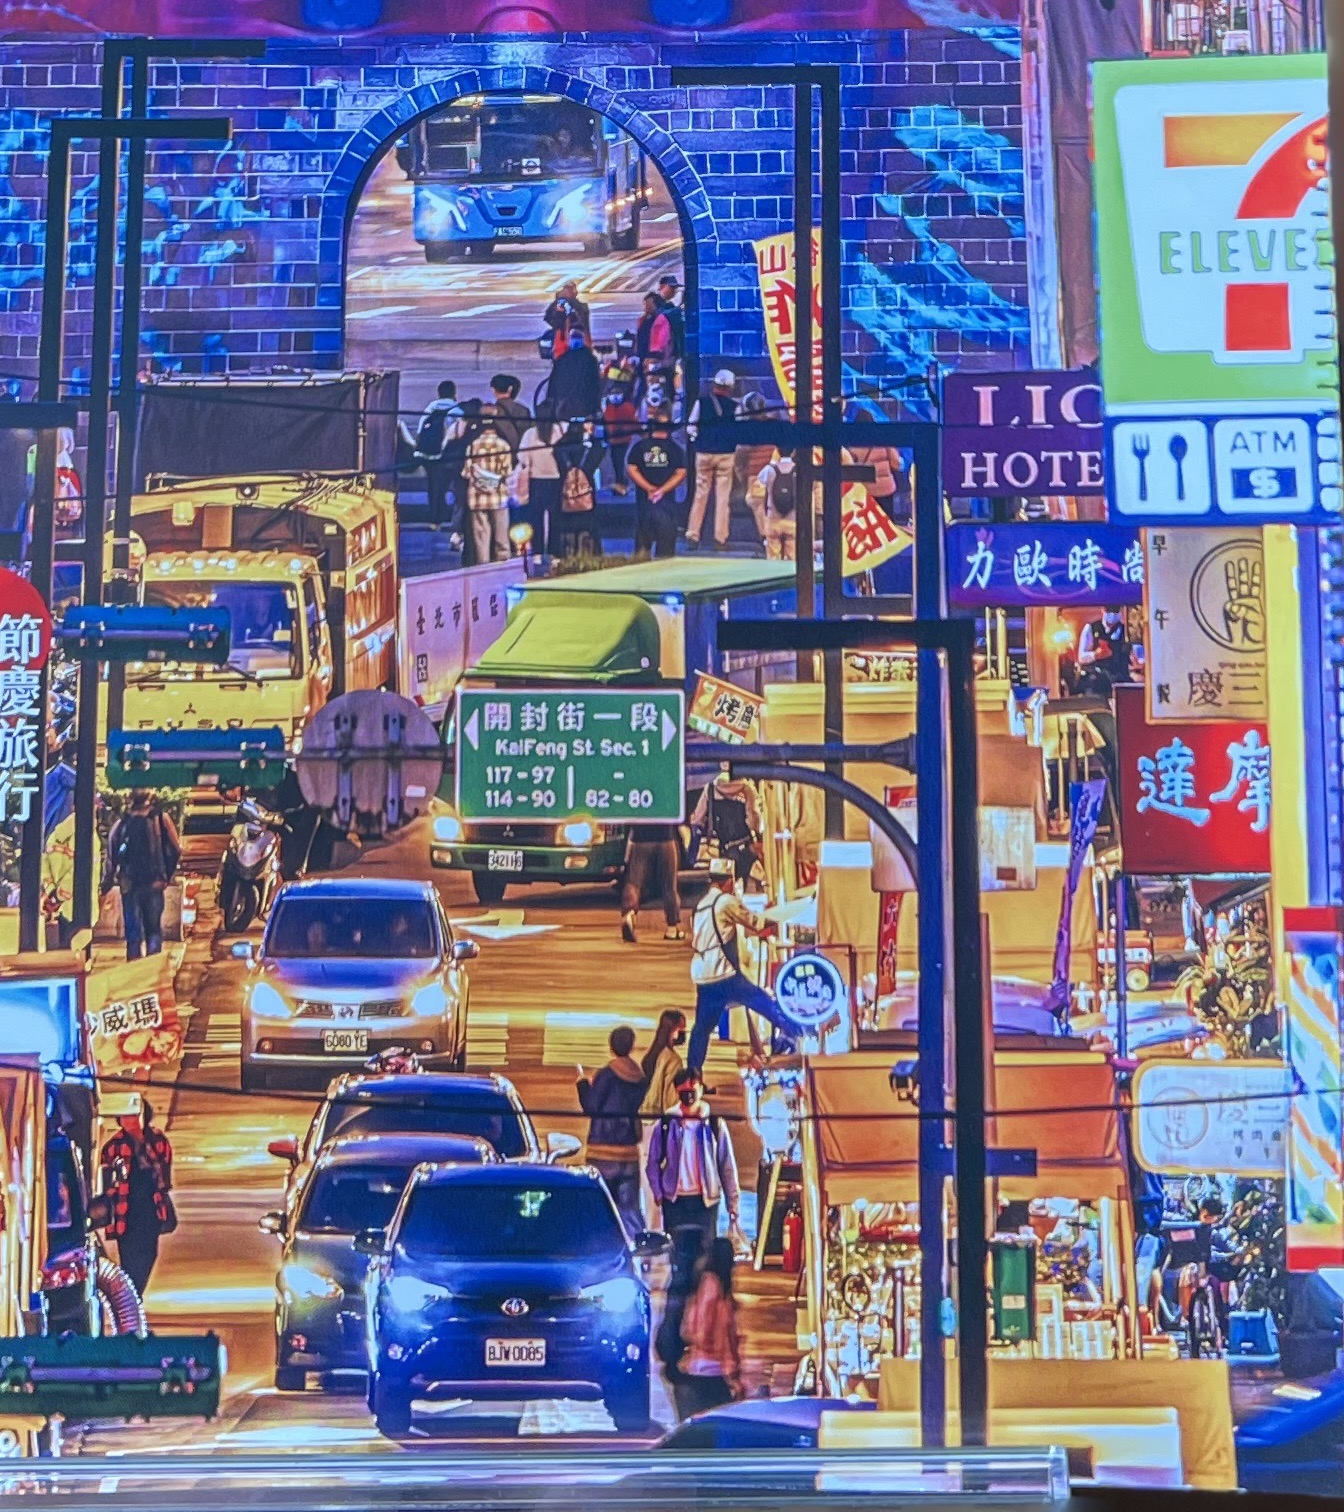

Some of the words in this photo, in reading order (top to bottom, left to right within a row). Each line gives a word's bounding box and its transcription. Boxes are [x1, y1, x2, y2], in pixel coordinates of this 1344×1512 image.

[1159, 228, 1332, 274] ELEVE
[1229, 430, 1297, 454] ATM
[960, 450, 1104, 489] HOTE
[484, 701, 658, 732] 開封街一段
[495, 738, 568, 761] KaiFeng
[600, 738, 637, 756] Sec.
[641, 738, 650, 756] 1
